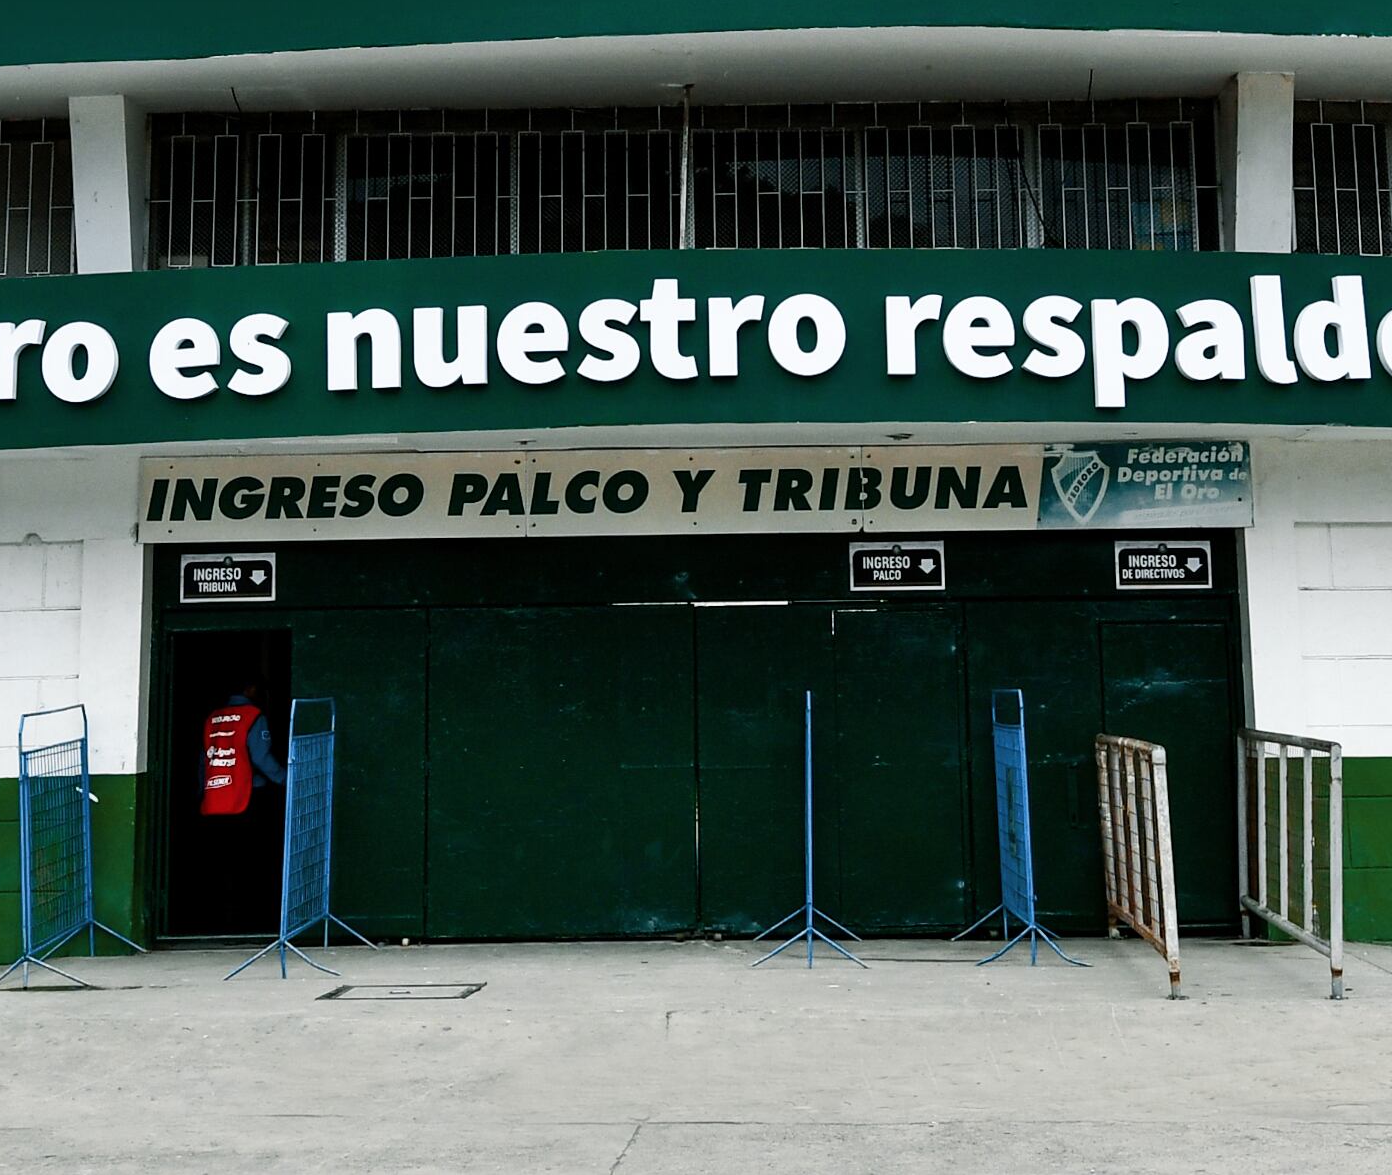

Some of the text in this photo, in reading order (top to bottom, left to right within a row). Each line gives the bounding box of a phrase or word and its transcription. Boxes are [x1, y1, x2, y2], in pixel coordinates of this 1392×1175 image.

[148, 312, 292, 400] es
[326, 278, 847, 391] nuestro
[1127, 445, 1244, 465] Federación
[1066, 461, 1100, 504] FEDEORO
[1117, 464, 1248, 486] Deportiva de
[145, 465, 1029, 522] INGRESO PALCO Y TRIBUNA
[1154, 484, 1220, 501] El Oro
[862, 555, 911, 570] INGRESO
[1128, 554, 1177, 568] INGRESO
[193, 567, 242, 581] INGRESO
[873, 569, 902, 581] PALCO
[1122, 568, 1186, 580] DE DIRECTIVOS
[197, 581, 238, 593] TRIBUNA
